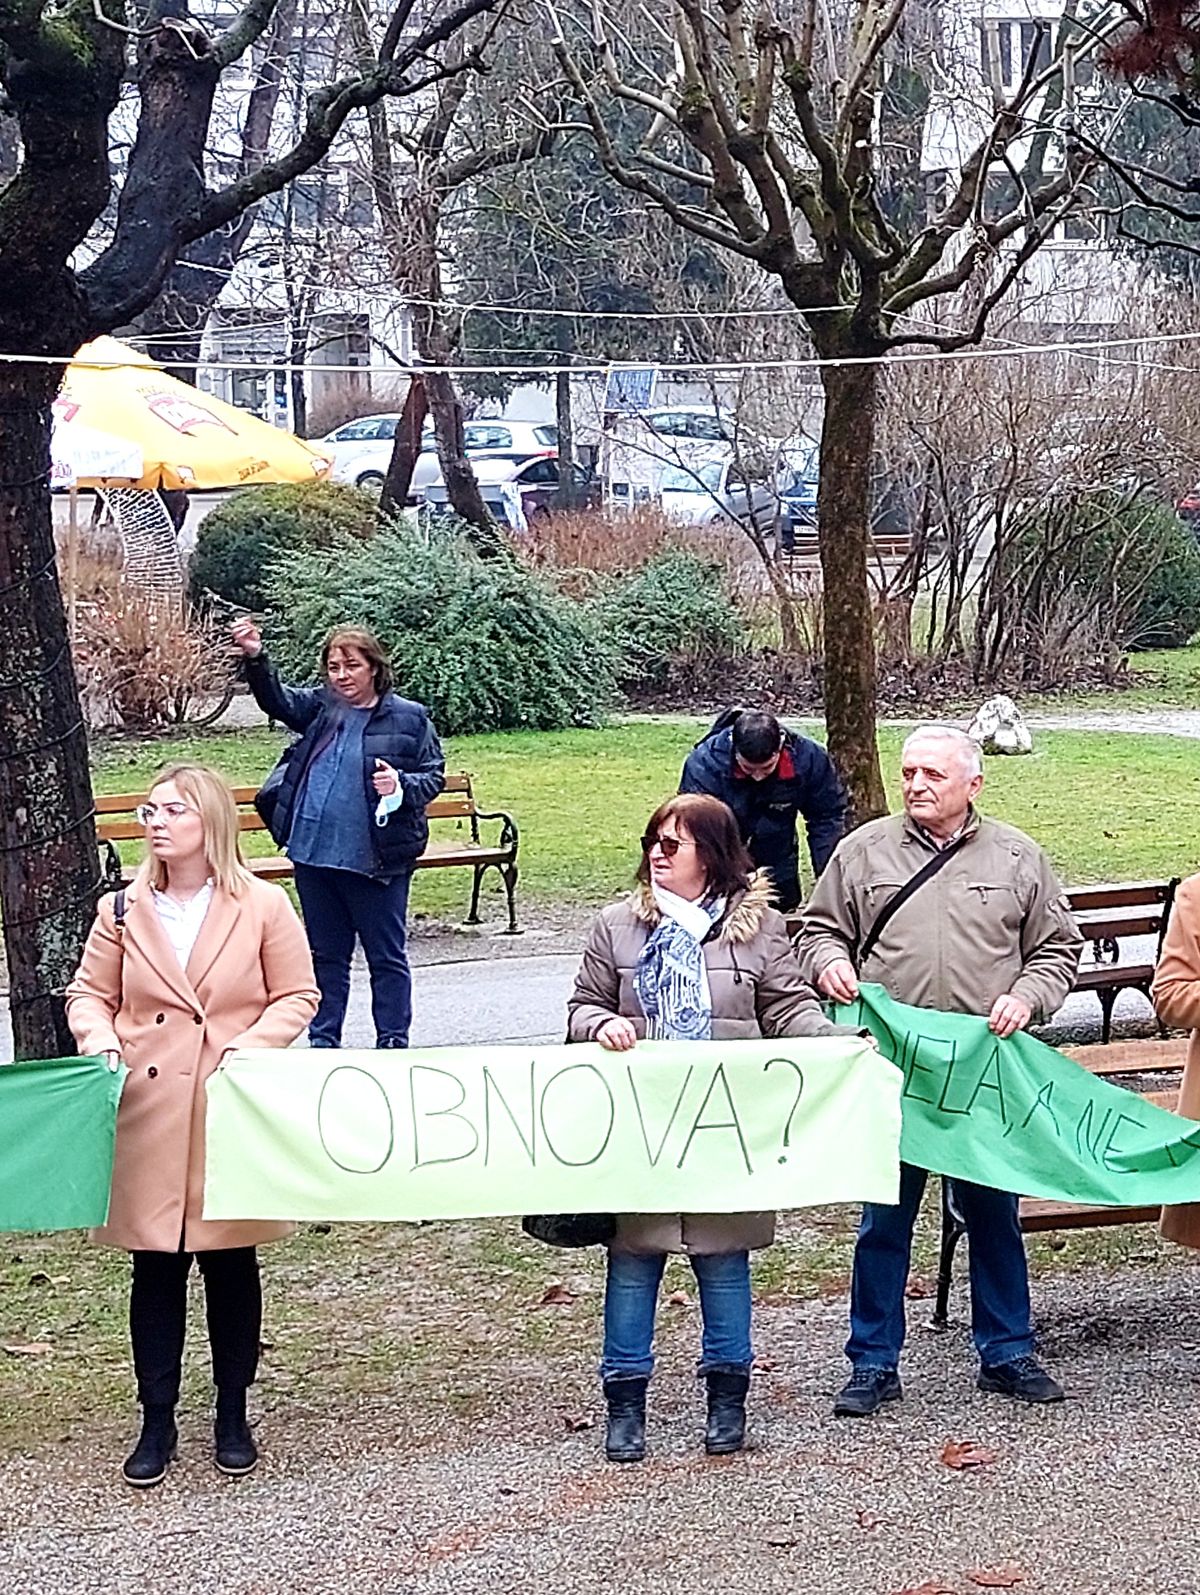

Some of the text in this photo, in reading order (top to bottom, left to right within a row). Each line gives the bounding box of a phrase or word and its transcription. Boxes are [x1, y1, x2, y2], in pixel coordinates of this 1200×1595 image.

[317, 1058, 804, 1176] OBNOVA?
[1022, 1080, 1060, 1137] A
[1076, 1098, 1148, 1174] NE
